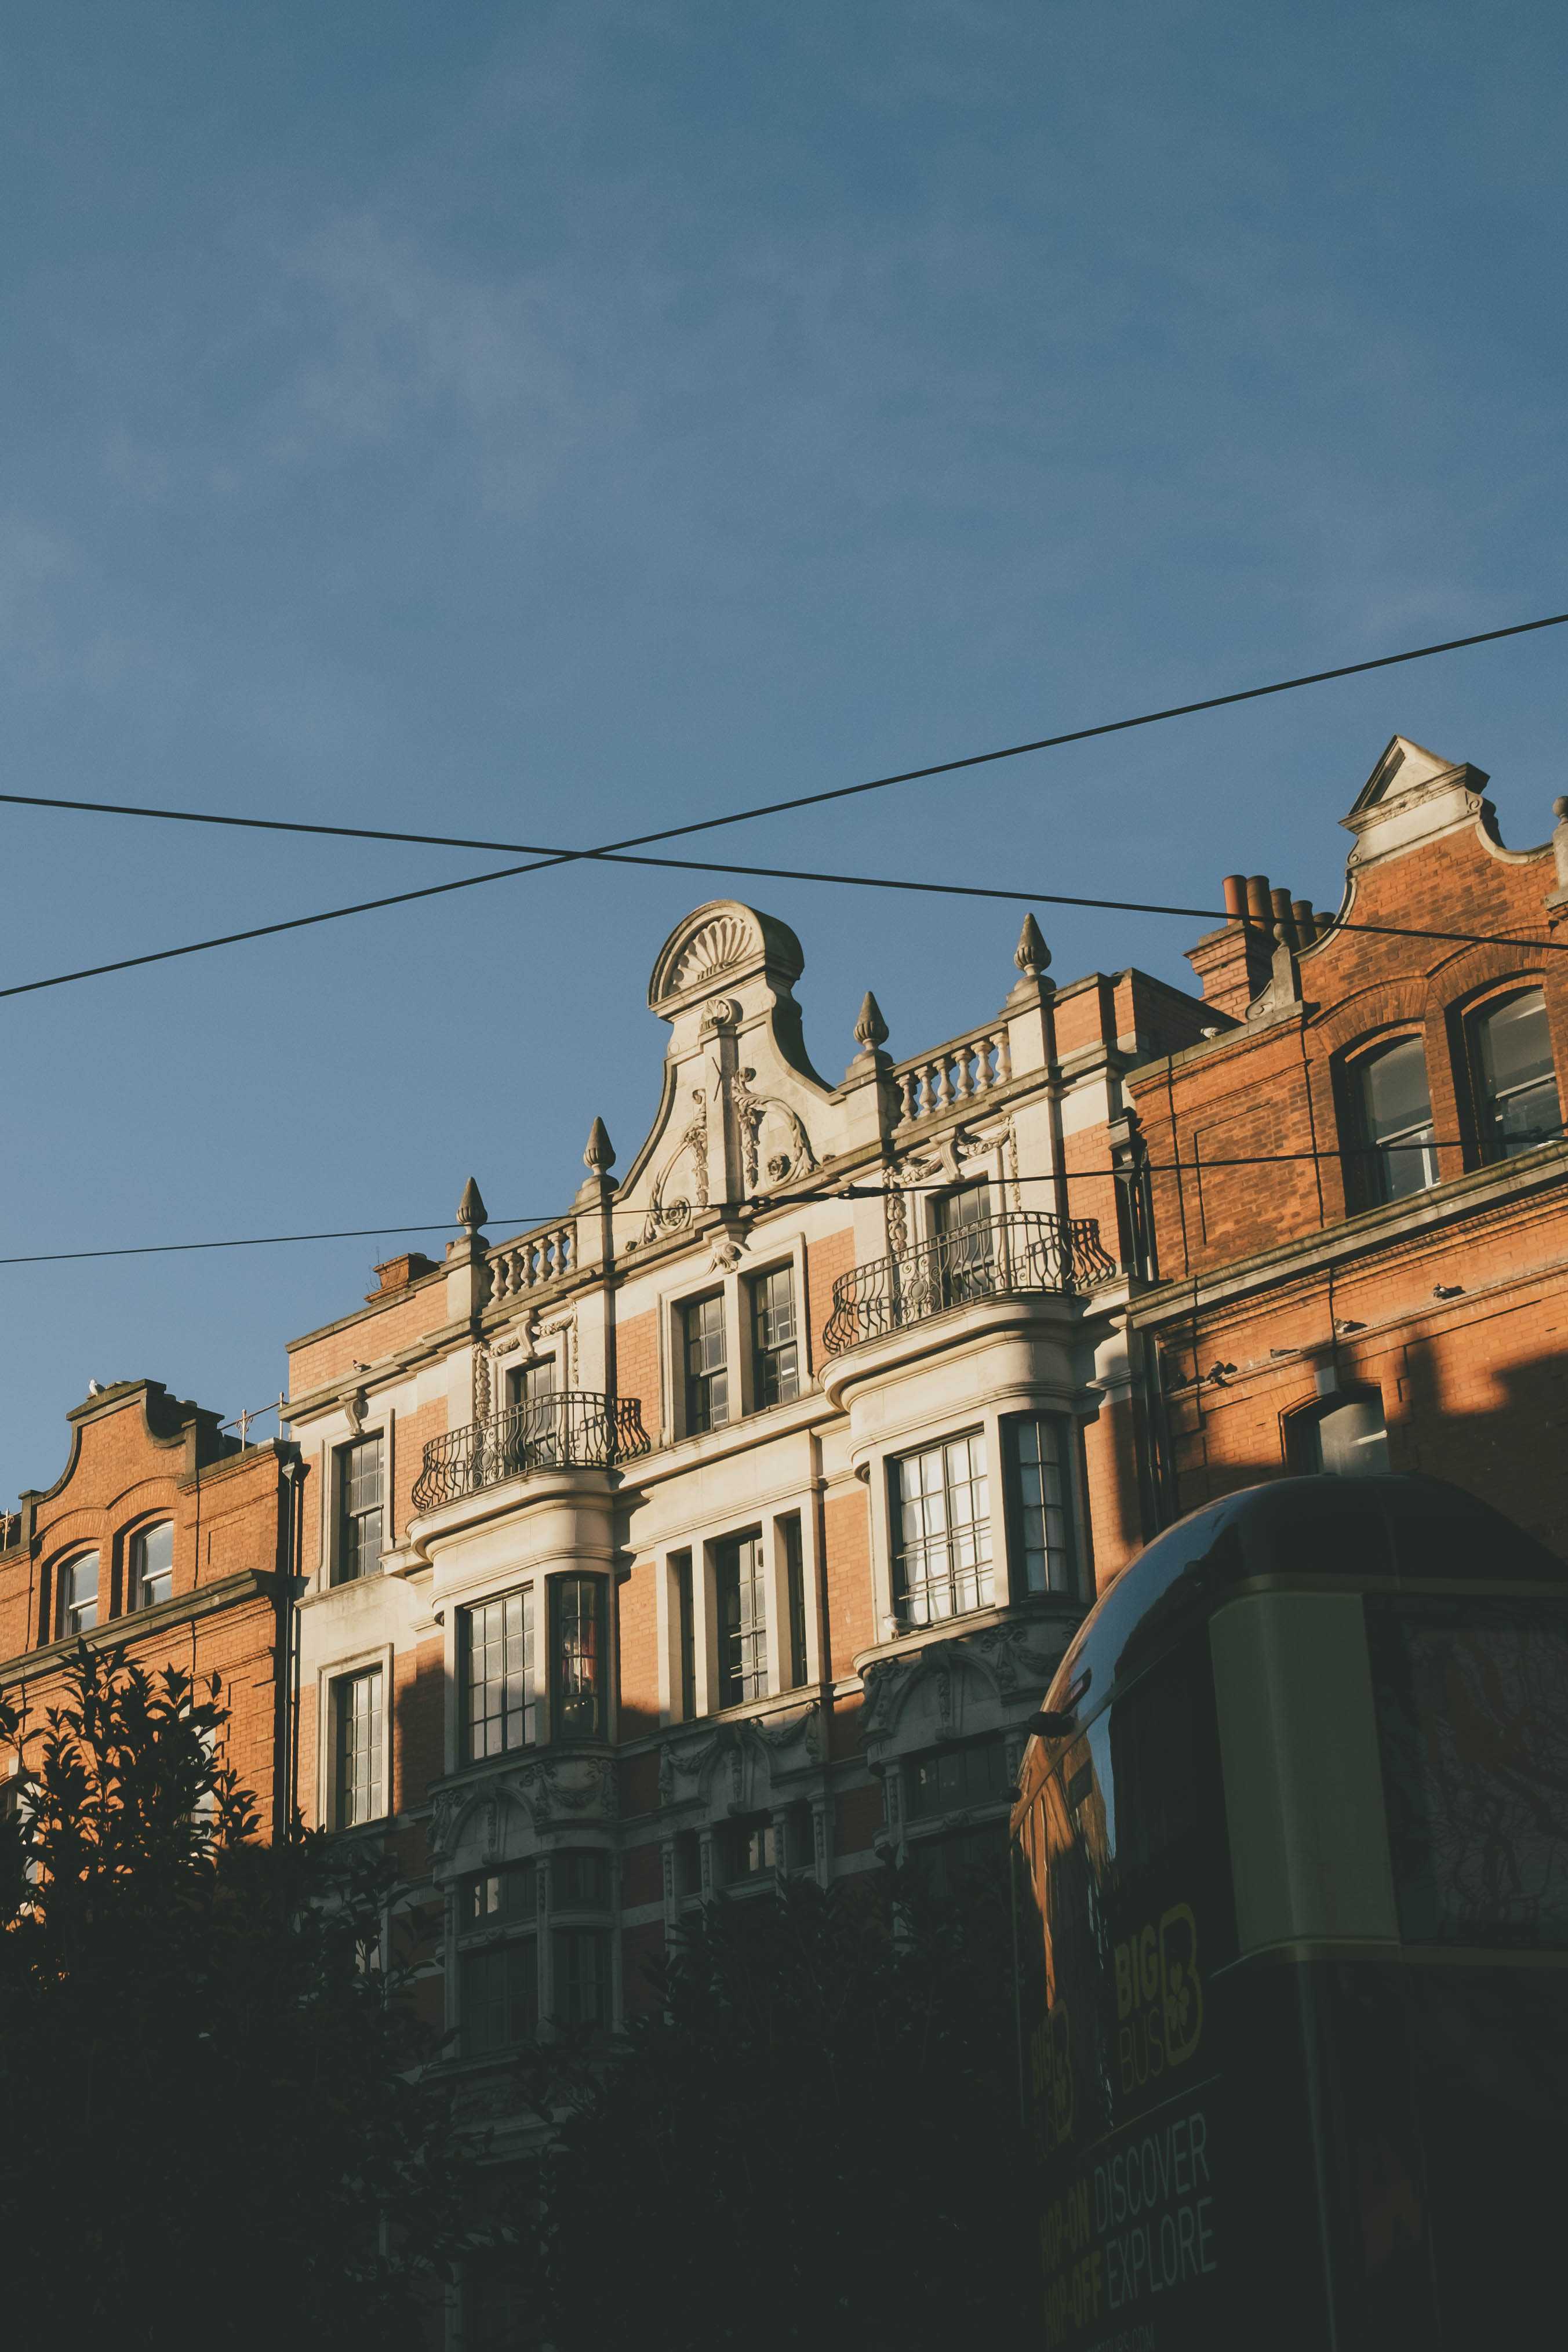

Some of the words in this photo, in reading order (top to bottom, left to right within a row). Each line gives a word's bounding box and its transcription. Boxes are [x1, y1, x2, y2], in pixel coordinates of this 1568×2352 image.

[1115, 1925, 1159, 2020] BIG
[1119, 2006, 1165, 2095] BUS
[1039, 2177, 1090, 2273] HOP-ON
[1094, 2112, 1210, 2233] DISCOVER
[1044, 2250, 1101, 2351] HOP-OFF
[1106, 2196, 1217, 2310] EXPLORE
